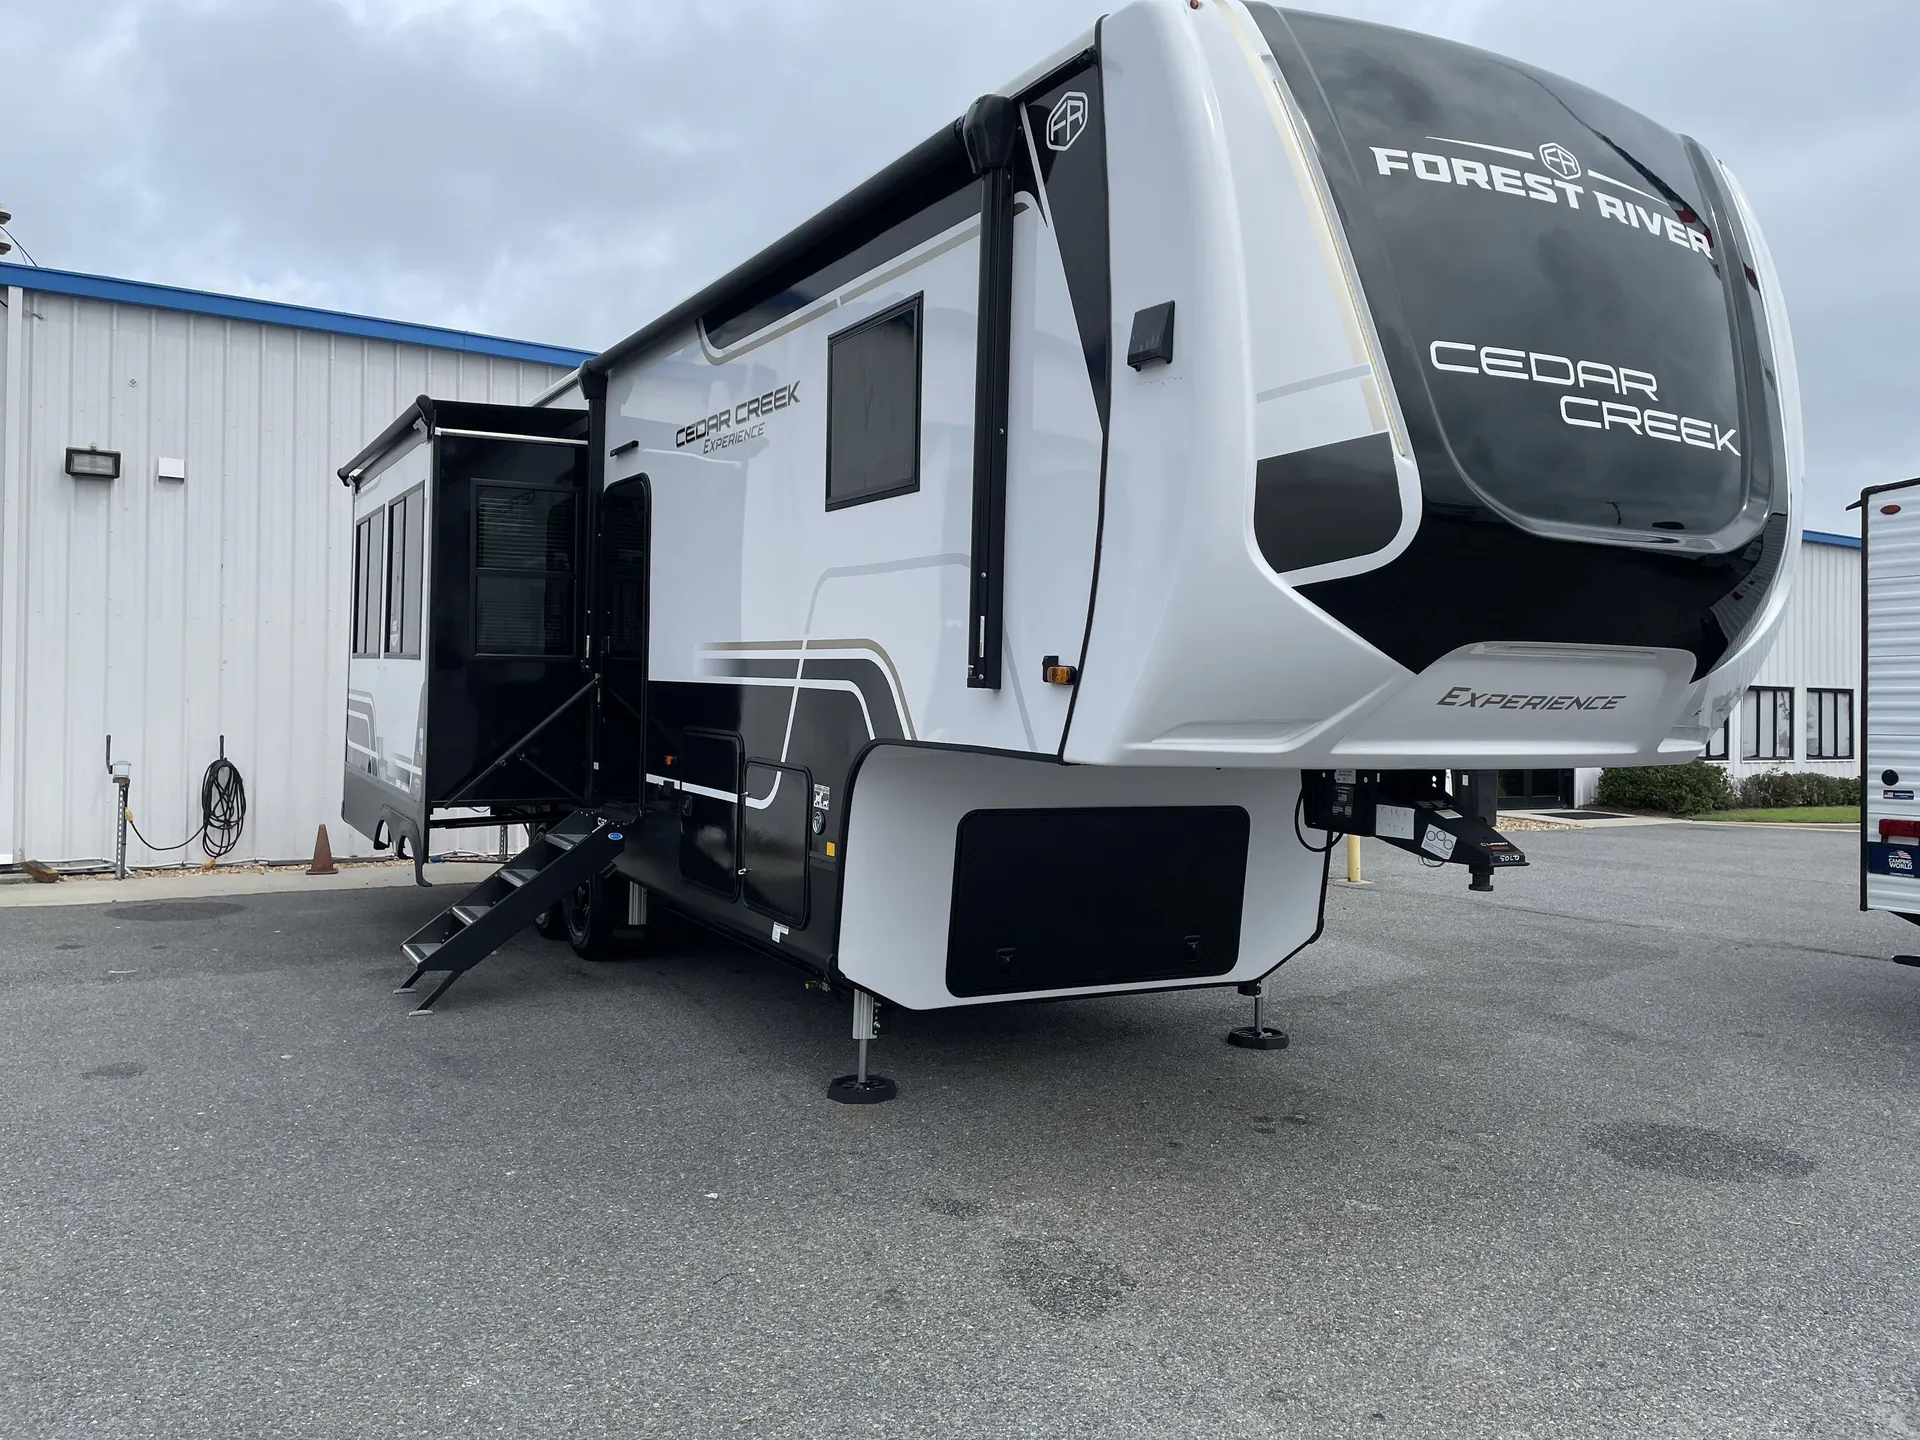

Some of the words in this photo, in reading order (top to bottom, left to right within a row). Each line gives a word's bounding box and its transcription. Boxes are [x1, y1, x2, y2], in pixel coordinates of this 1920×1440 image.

[1369, 146, 1584, 209] FOREST
[1592, 190, 1714, 260] RIVER
[1430, 340, 1659, 401] CEDAR
[675, 409, 731, 448] CEDAR
[735, 379, 801, 425] CREEK
[703, 422, 766, 454] EXPERIENCE
[1560, 395, 1741, 456] CREEK
[1436, 686, 1626, 711] EXPERIENCE
[1889, 862, 1913, 870] WORLD
